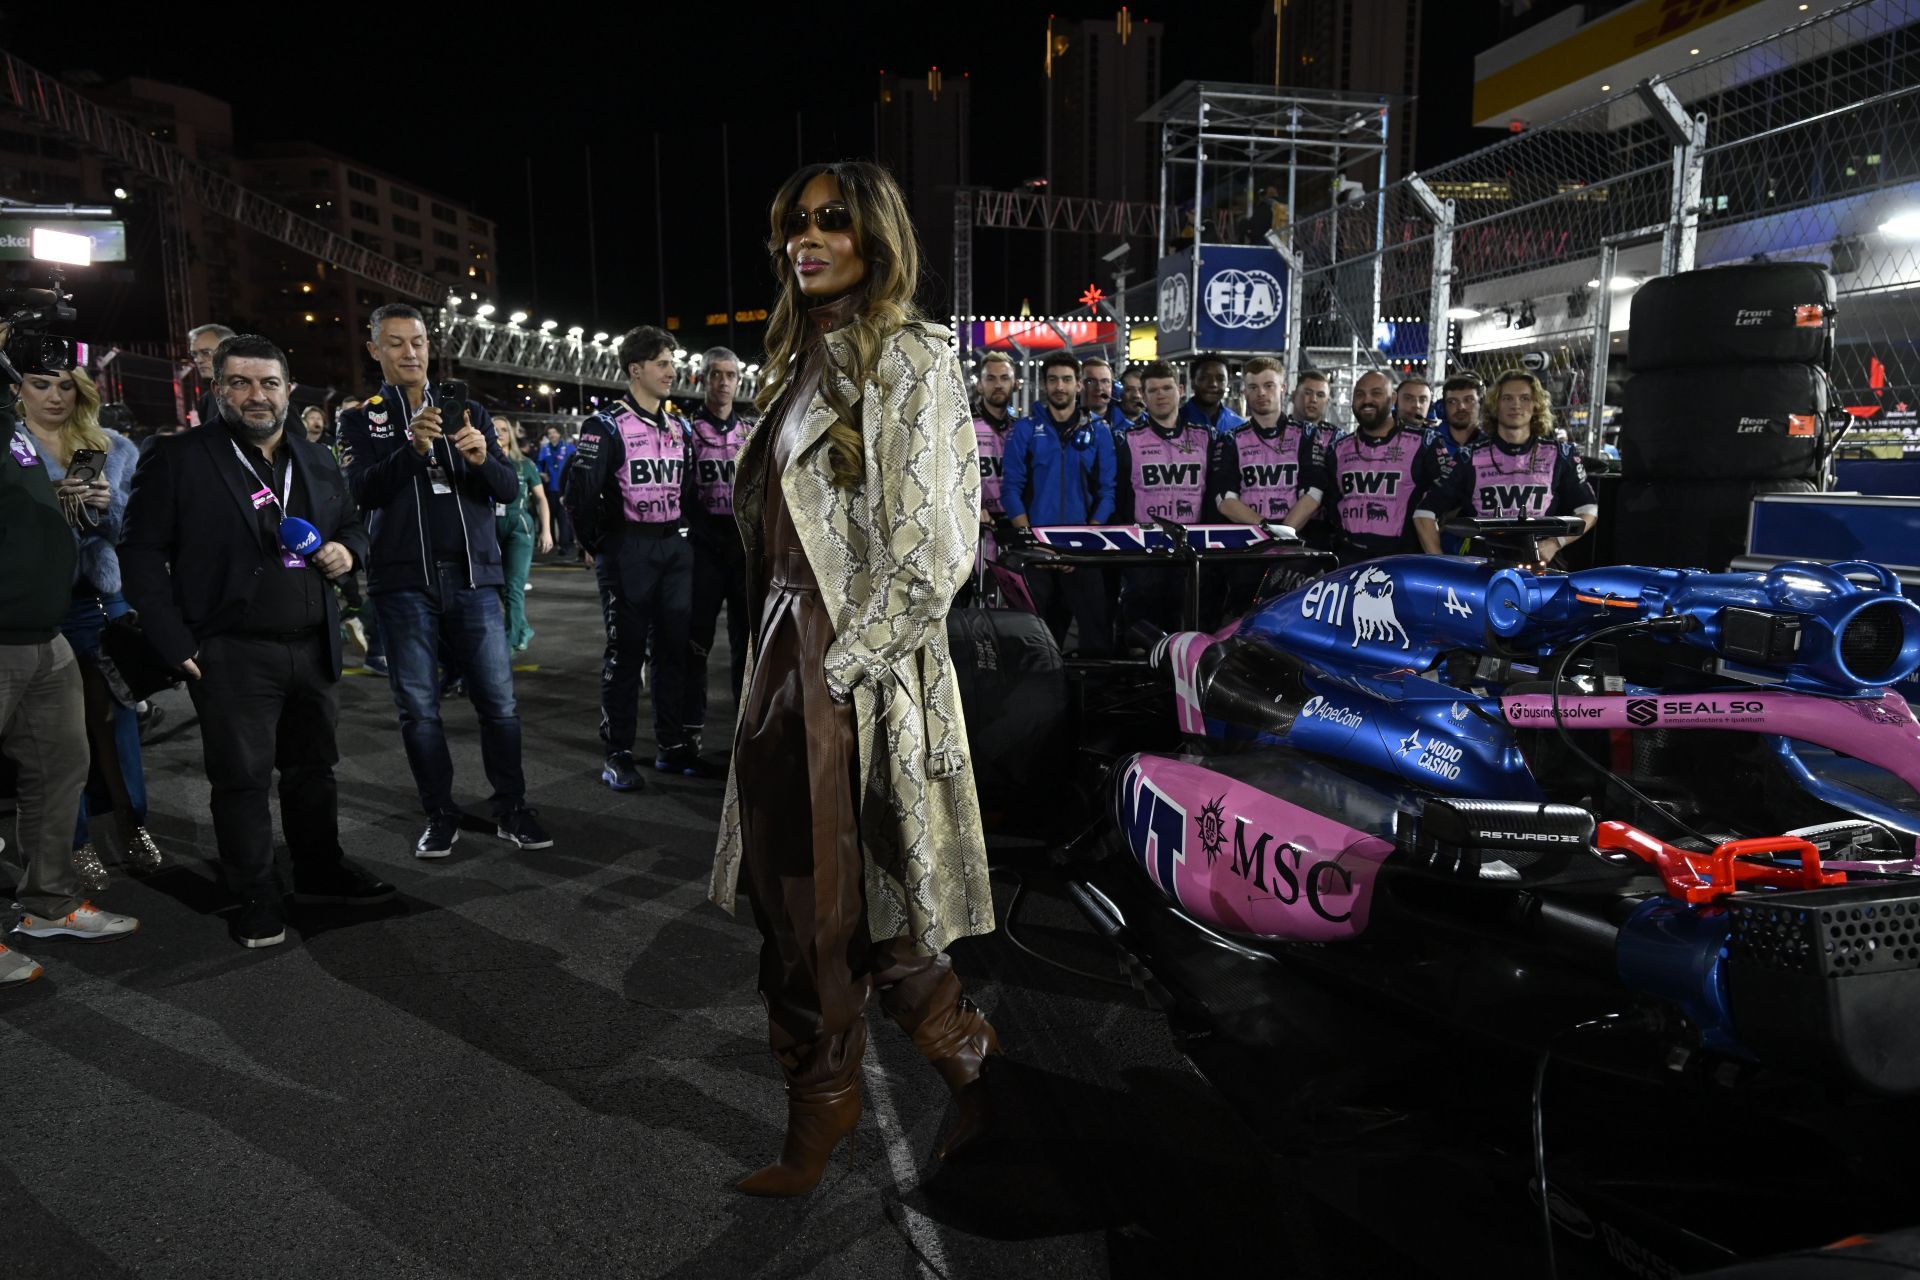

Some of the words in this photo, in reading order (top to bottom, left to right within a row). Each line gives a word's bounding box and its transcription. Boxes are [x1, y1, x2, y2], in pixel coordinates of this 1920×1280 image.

[1735, 317, 1764, 326] Left
[1737, 309, 1773, 318] Front
[1736, 425, 1765, 433] Left
[1739, 416, 1771, 425] Rear
[629, 458, 684, 486] BWT
[1141, 463, 1201, 487] BWT
[1241, 463, 1299, 488] BWT
[1341, 471, 1402, 496] BWT
[1146, 500, 1173, 517] eni
[1479, 485, 1549, 511] BWT
[1342, 503, 1364, 520] eni
[1301, 570, 1359, 628] eni
[1315, 701, 1364, 730] ApeCoin
[1663, 702, 1726, 715] SEAL
[1730, 701, 1765, 714] SQ
[1424, 737, 1463, 763] MODO
[1417, 752, 1461, 781] CASINO
[1230, 816, 1352, 923] MSC
